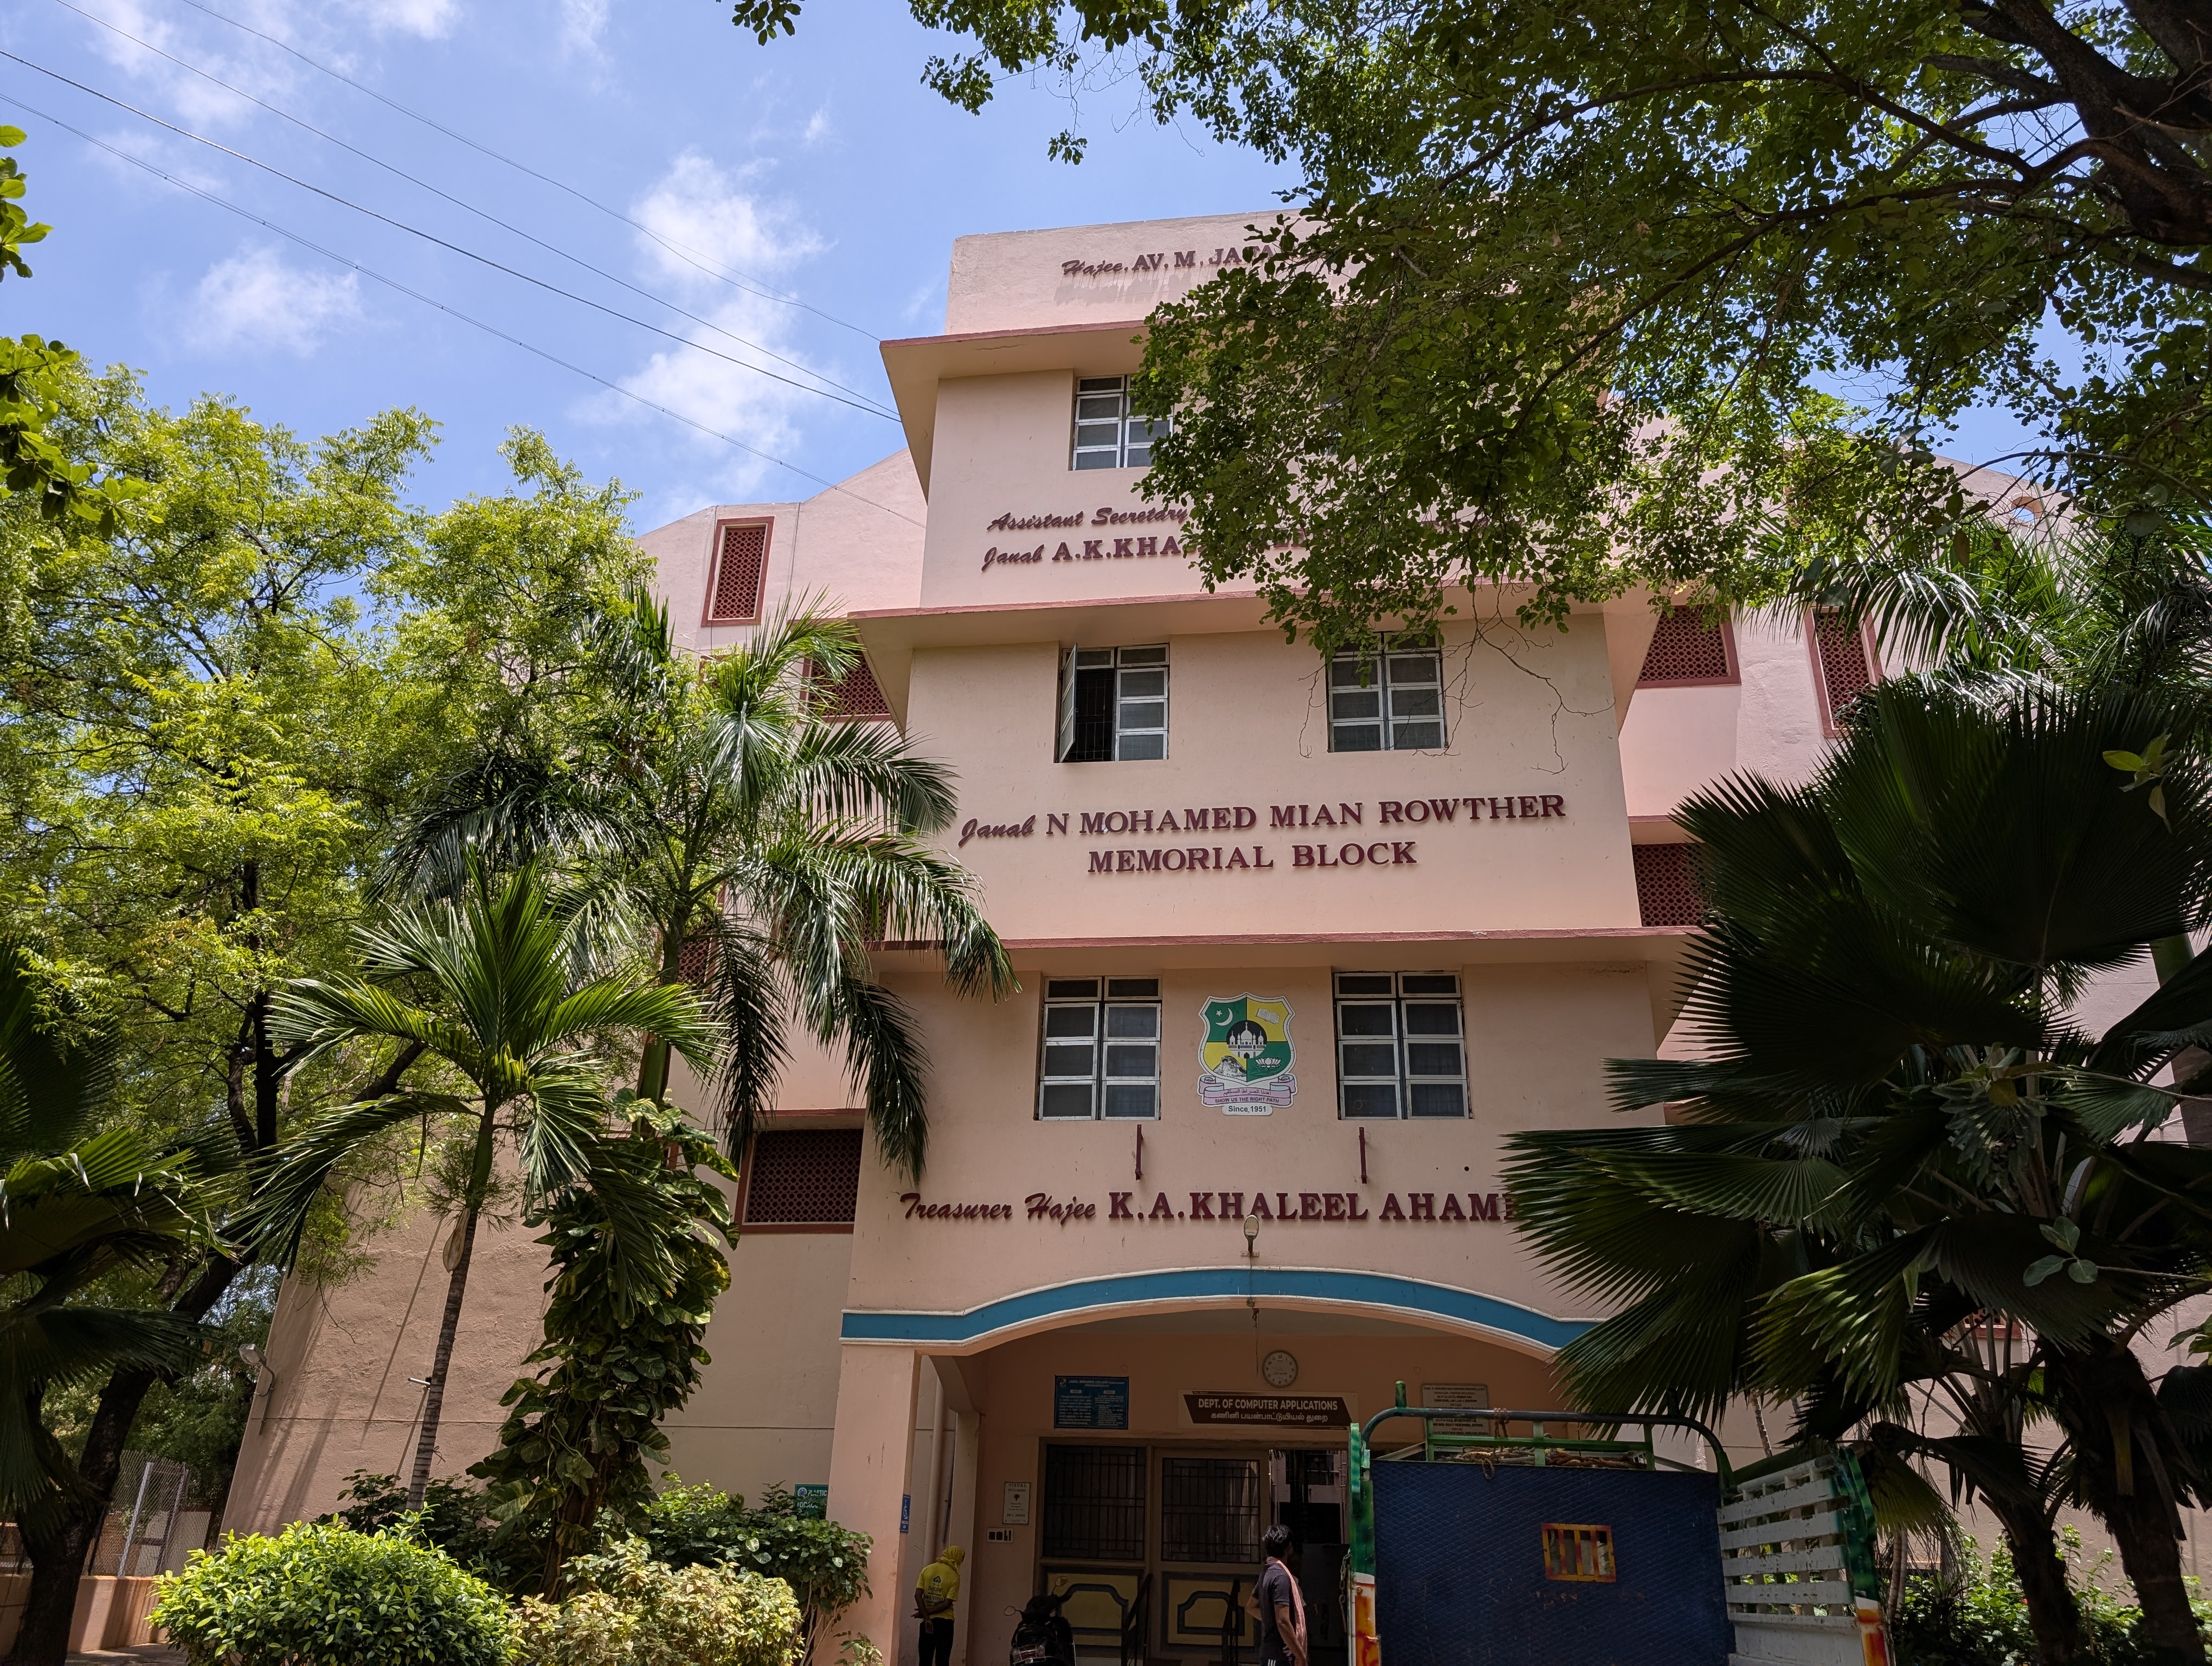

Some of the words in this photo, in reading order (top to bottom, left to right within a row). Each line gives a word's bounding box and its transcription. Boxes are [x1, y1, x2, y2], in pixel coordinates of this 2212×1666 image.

[986, 510, 1084, 530] Assistant
[1091, 507, 1188, 525] Secretary
[981, 544, 1045, 572] Janab
[957, 815, 1036, 847] Janab
[1046, 813, 1069, 835] N
[1079, 806, 1257, 834] MOHAMED
[1269, 802, 1363, 827] MIAN
[1378, 794, 1566, 823] ROWTHER
[1087, 845, 1274, 873] MEMORIAL
[1292, 841, 1417, 867] BLOCK
[899, 1192, 1013, 1219] Treasurer
[1024, 1192, 1096, 1226] Hajee
[1198, 1398, 1221, 1408] DEPT.
[1223, 1399, 1233, 1408] OF
[1234, 1399, 1278, 1409] COMPUTER
[1280, 1400, 1338, 1411] APPLICATIONS
[1306, 1414, 1328, 1423] துறை
